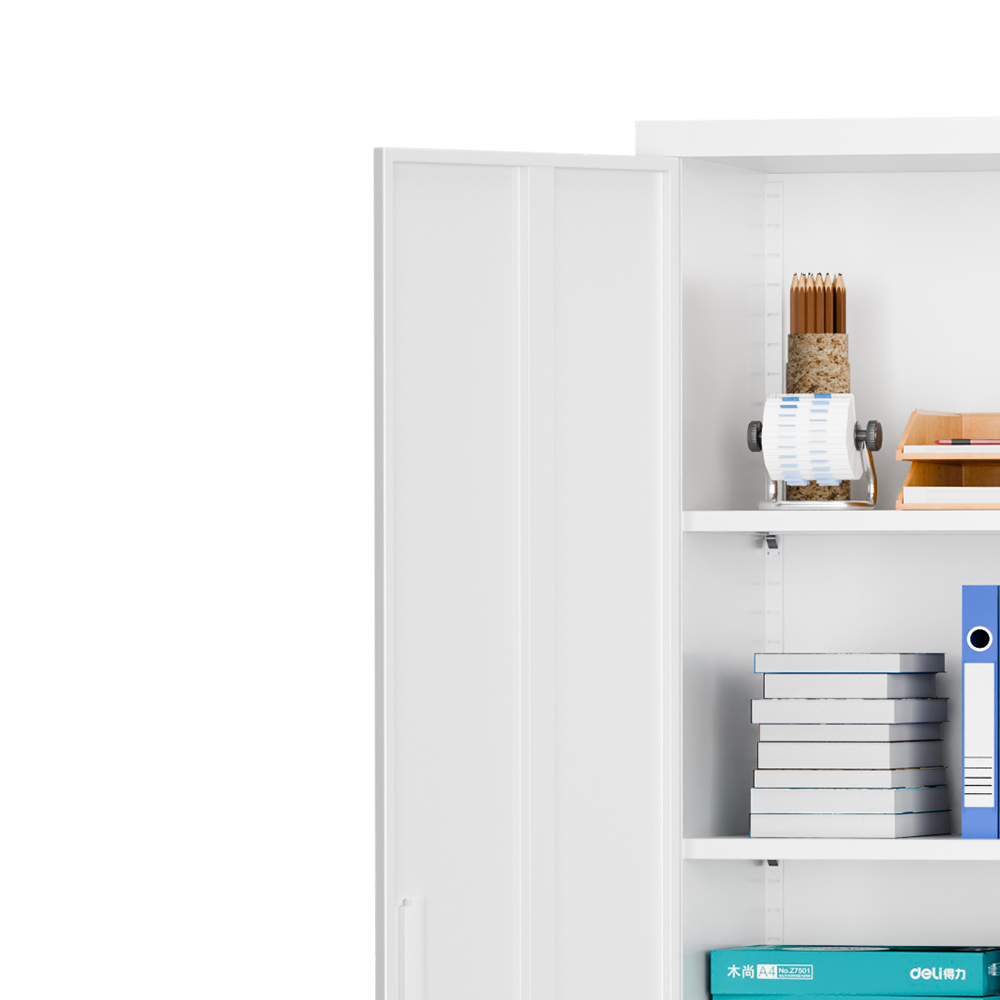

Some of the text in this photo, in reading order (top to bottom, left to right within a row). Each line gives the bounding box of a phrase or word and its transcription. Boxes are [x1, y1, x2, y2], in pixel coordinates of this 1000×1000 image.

[727, 964, 754, 979] 木尚
[758, 966, 776, 978] A4
[910, 967, 966, 980] deli得力
